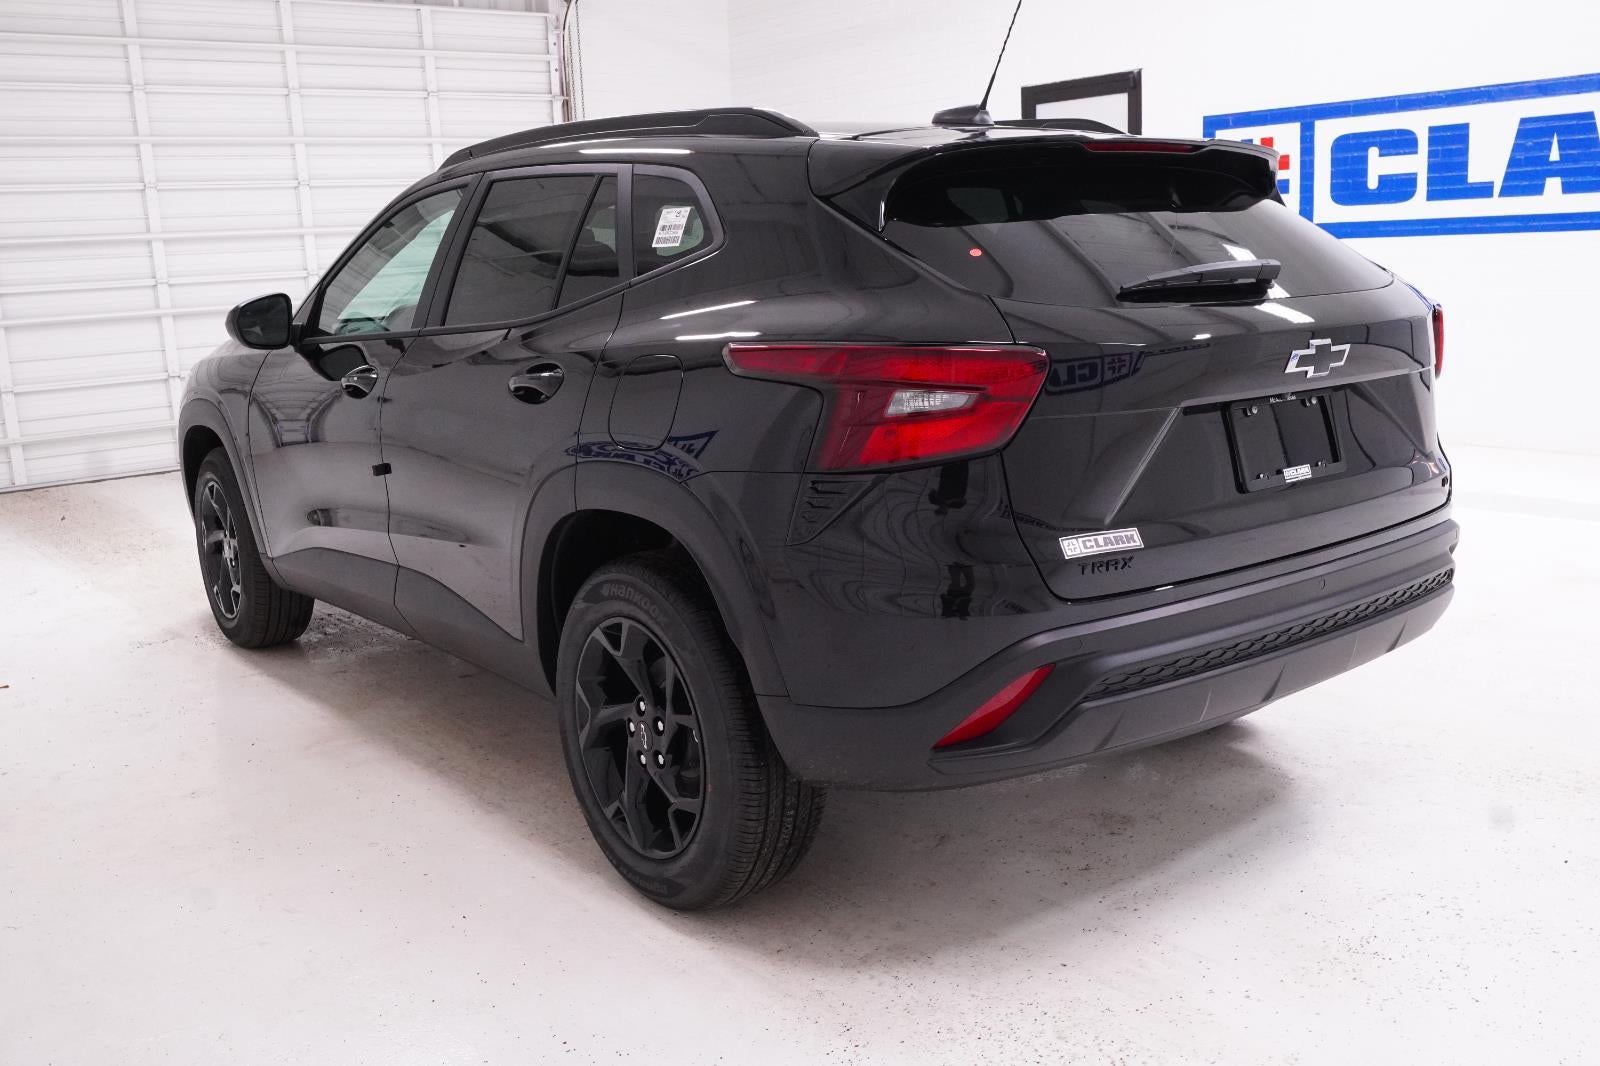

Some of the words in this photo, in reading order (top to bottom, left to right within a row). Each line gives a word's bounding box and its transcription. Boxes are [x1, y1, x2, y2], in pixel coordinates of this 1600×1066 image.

[1330, 111, 1600, 206] CLA
[1081, 533, 1137, 550] CLARK
[1078, 555, 1134, 575] TRAX
